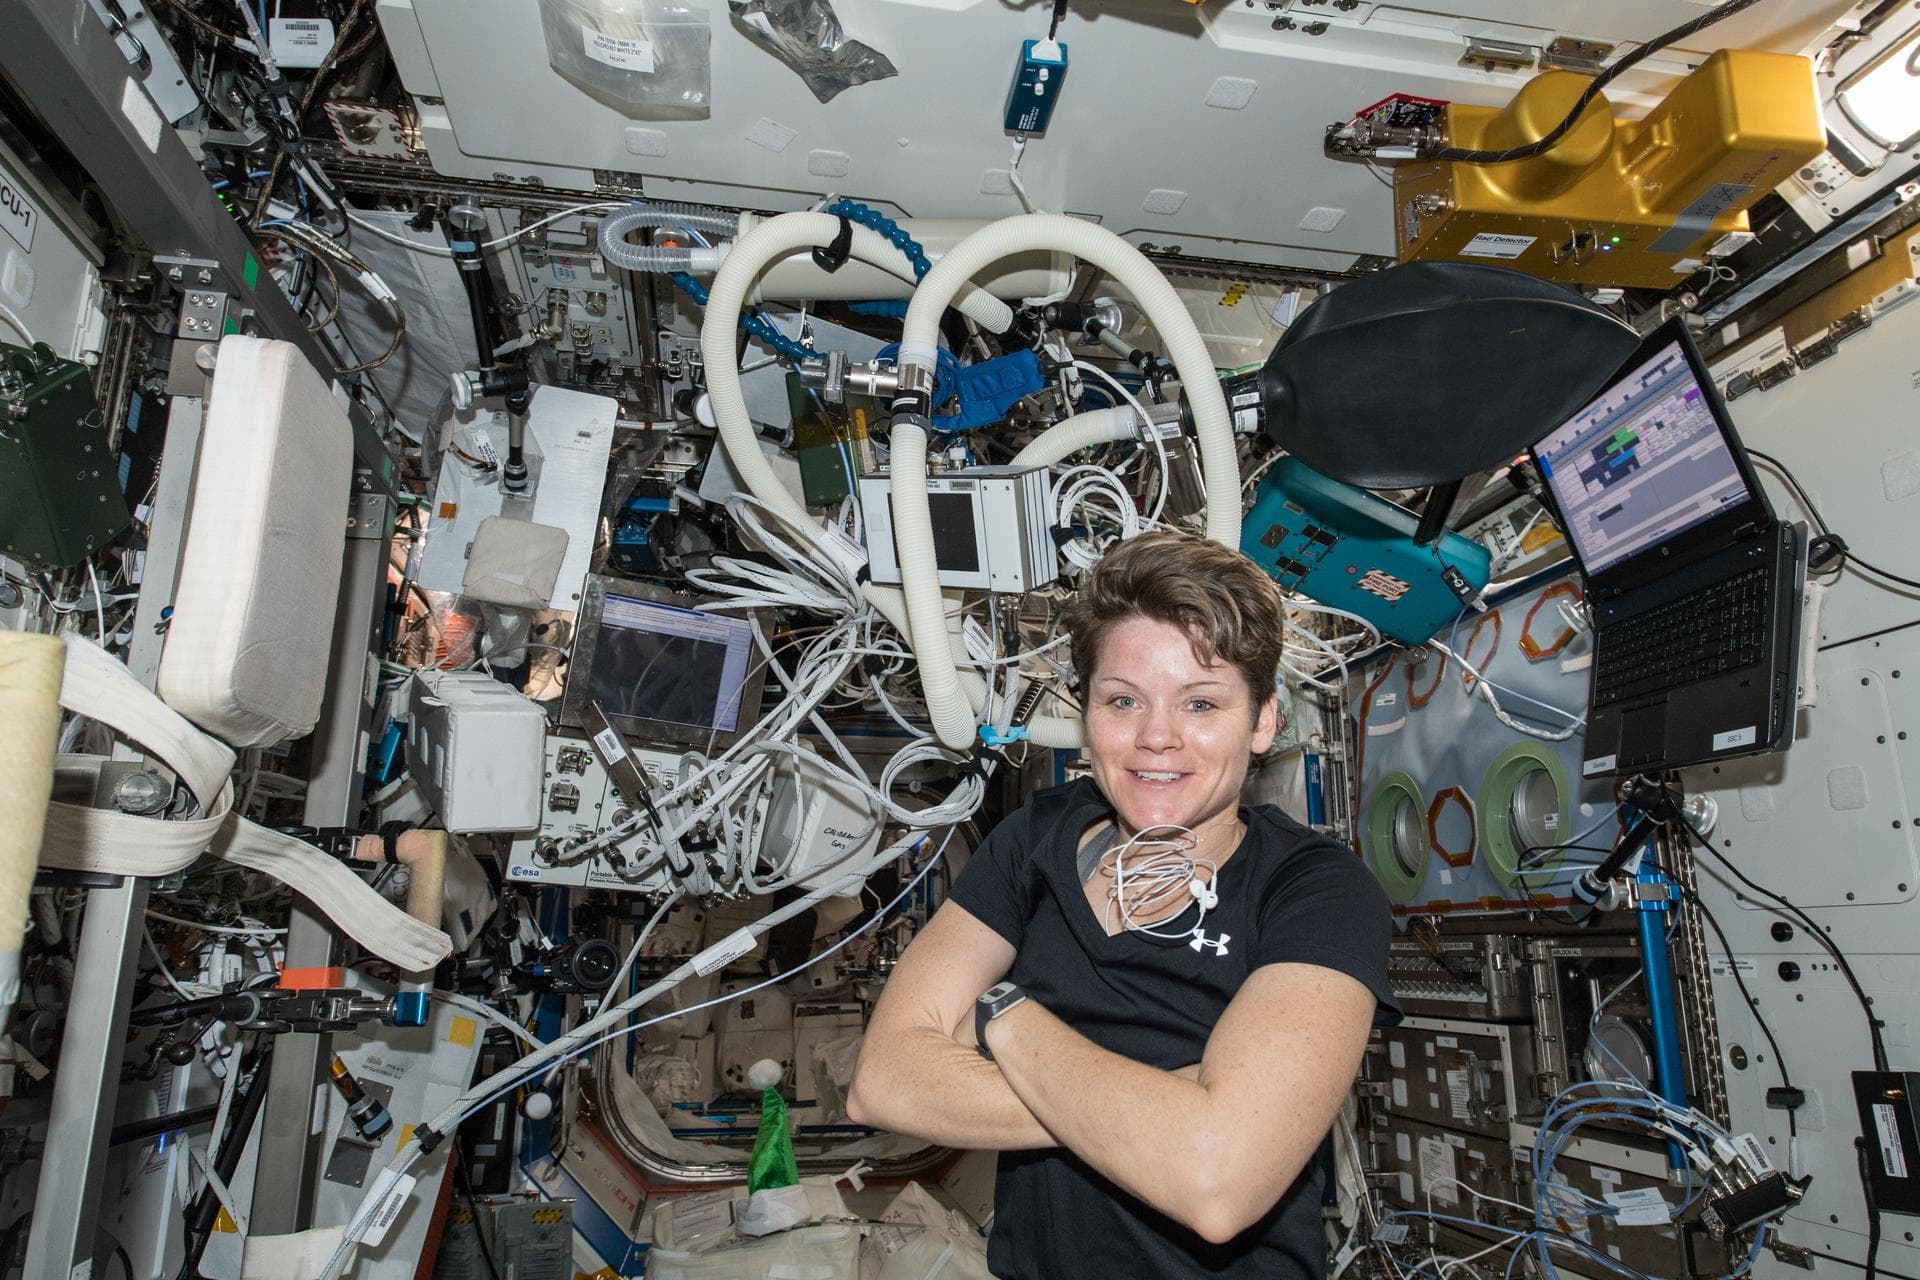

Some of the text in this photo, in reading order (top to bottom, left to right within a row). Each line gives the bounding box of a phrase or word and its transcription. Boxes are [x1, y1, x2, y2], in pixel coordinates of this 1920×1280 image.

[0, 182, 31, 228] CU-1
[1494, 236, 1531, 244] Detector
[522, 869, 540, 877] esa
[590, 870, 613, 878] Portable
